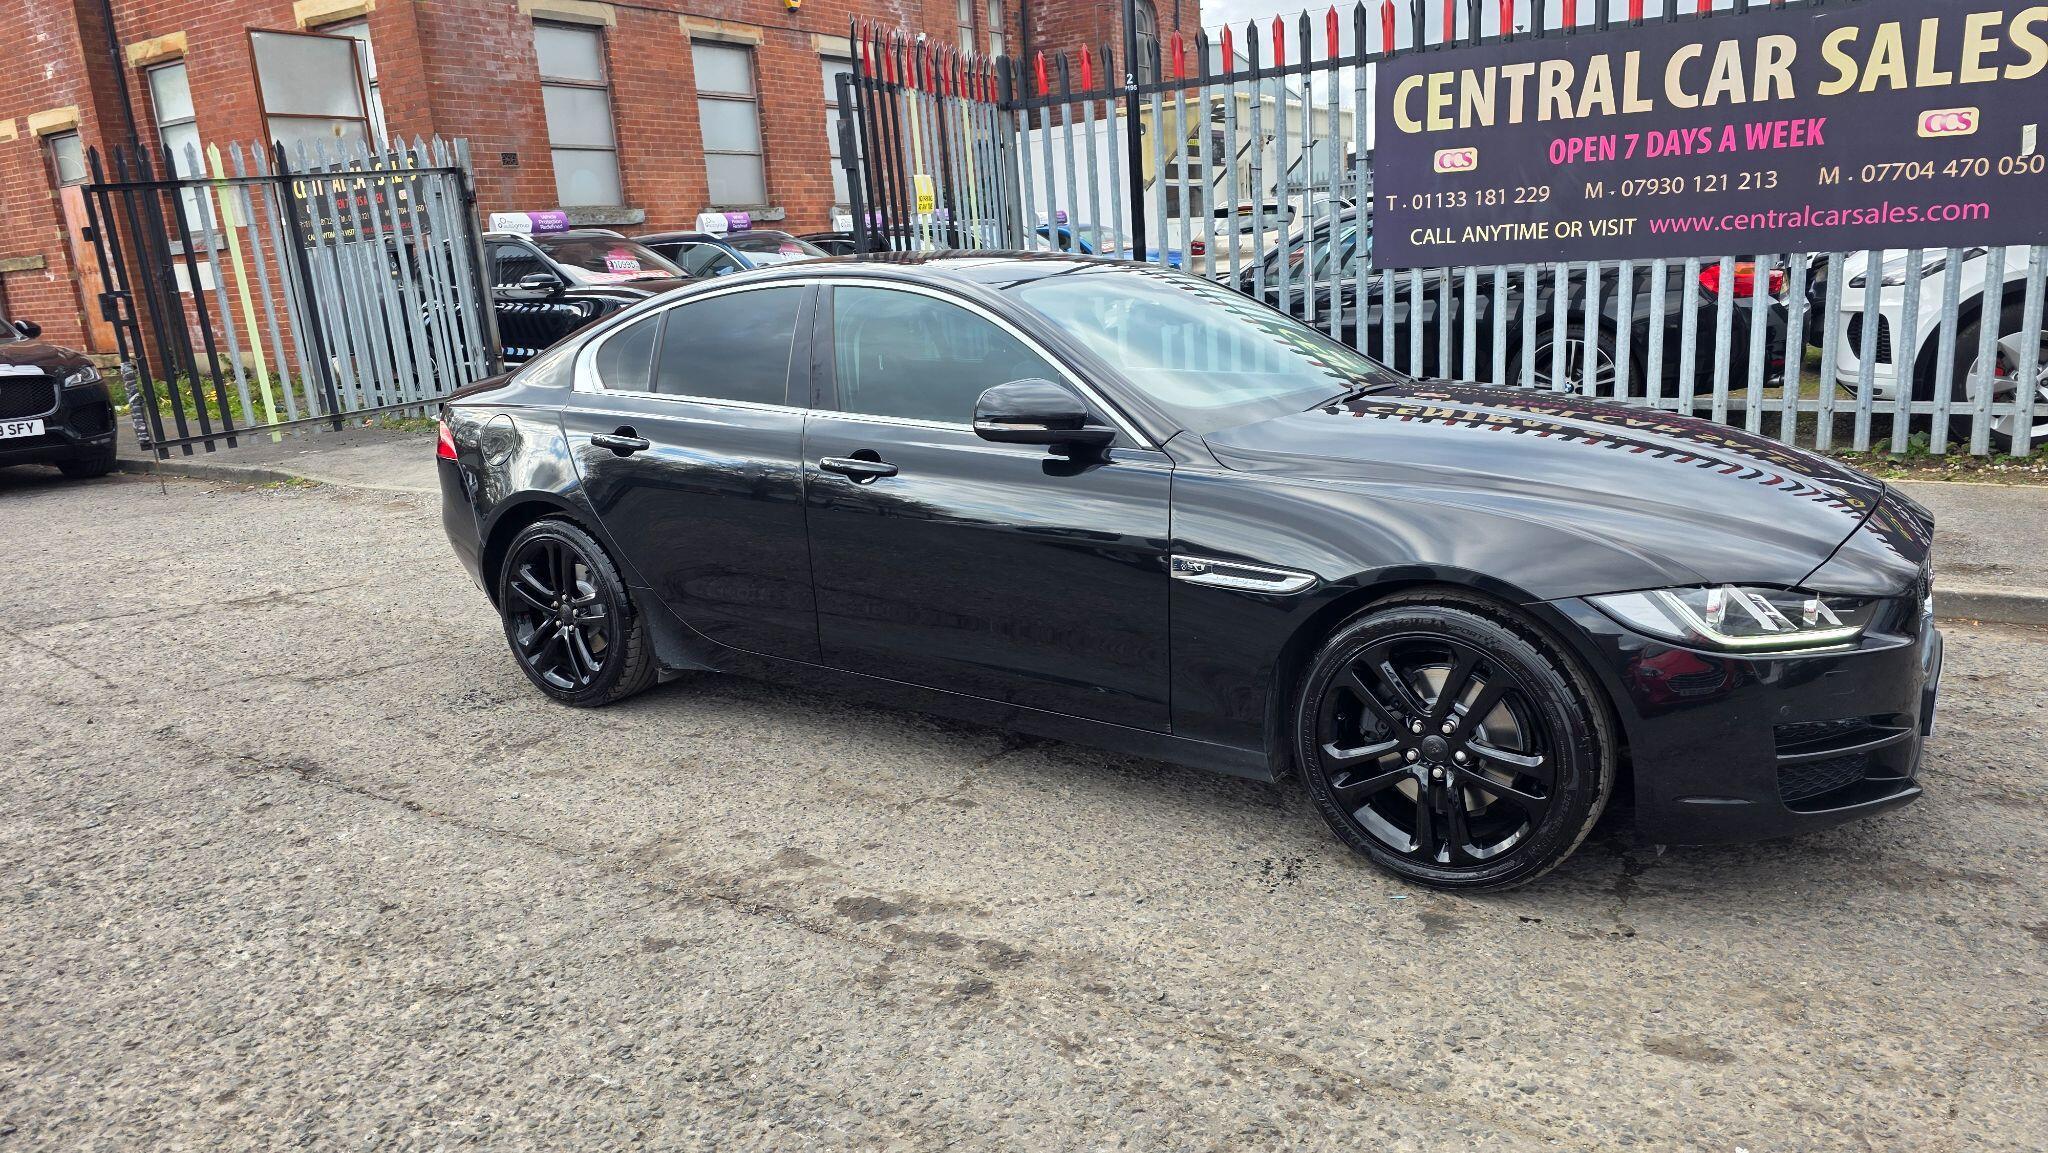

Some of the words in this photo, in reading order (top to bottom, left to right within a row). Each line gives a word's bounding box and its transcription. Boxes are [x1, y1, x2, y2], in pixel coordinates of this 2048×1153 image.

[1126, 73, 1134, 84] 2
[1393, 50, 1653, 134] CENTRAL
[1664, 34, 1797, 109] CAR
[1818, 6, 2048, 96] SALES
[1924, 111, 1972, 133] CCS
[1549, 134, 1616, 165] OPEN
[1624, 133, 1640, 160] 7
[1647, 126, 1712, 158] DAYS
[1718, 124, 1737, 152] A
[1744, 116, 1827, 151] WEEK
[1438, 151, 1473, 169] CCS
[1861, 160, 1935, 184] 07704
[1942, 157, 1990, 178] 470
[1998, 153, 2046, 176] 050
[1621, 176, 1685, 197] 07930
[1693, 173, 1728, 193] 121
[1738, 170, 1778, 190] 213
[1412, 191, 1467, 210] 01133
[1475, 188, 1506, 206] 181
[1514, 185, 1551, 204] 229
[1410, 227, 1456, 246] CALL
[1462, 221, 1549, 243] ANYTIME
[1554, 220, 1583, 239] OR
[1589, 217, 1638, 237] VISIT
[1649, 201, 1990, 234] www.centralcarsales.com
[7, 421, 34, 435] SFY
